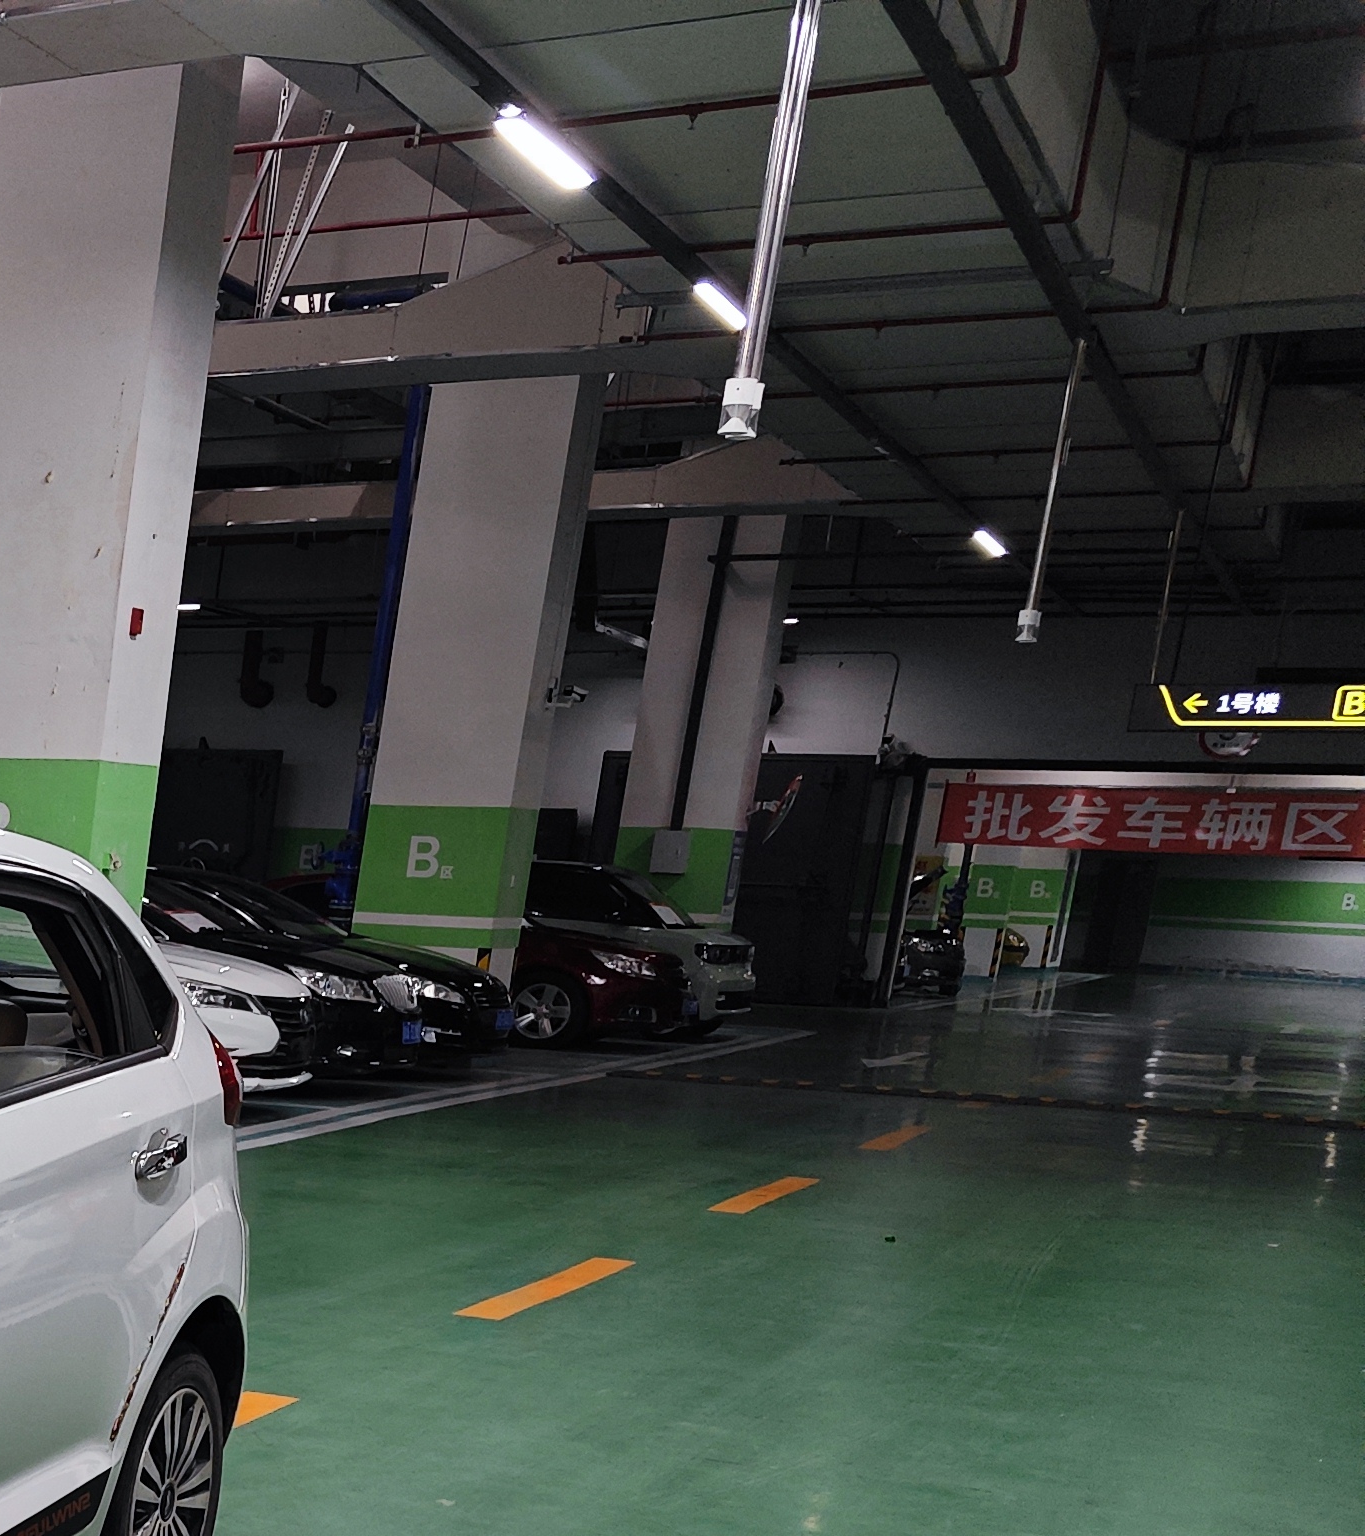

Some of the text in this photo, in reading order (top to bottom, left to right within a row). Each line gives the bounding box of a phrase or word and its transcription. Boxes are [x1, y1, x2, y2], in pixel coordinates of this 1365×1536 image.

[1216, 692, 1280, 714] 1号楼
[963, 790, 1359, 853] 批发车辆区
